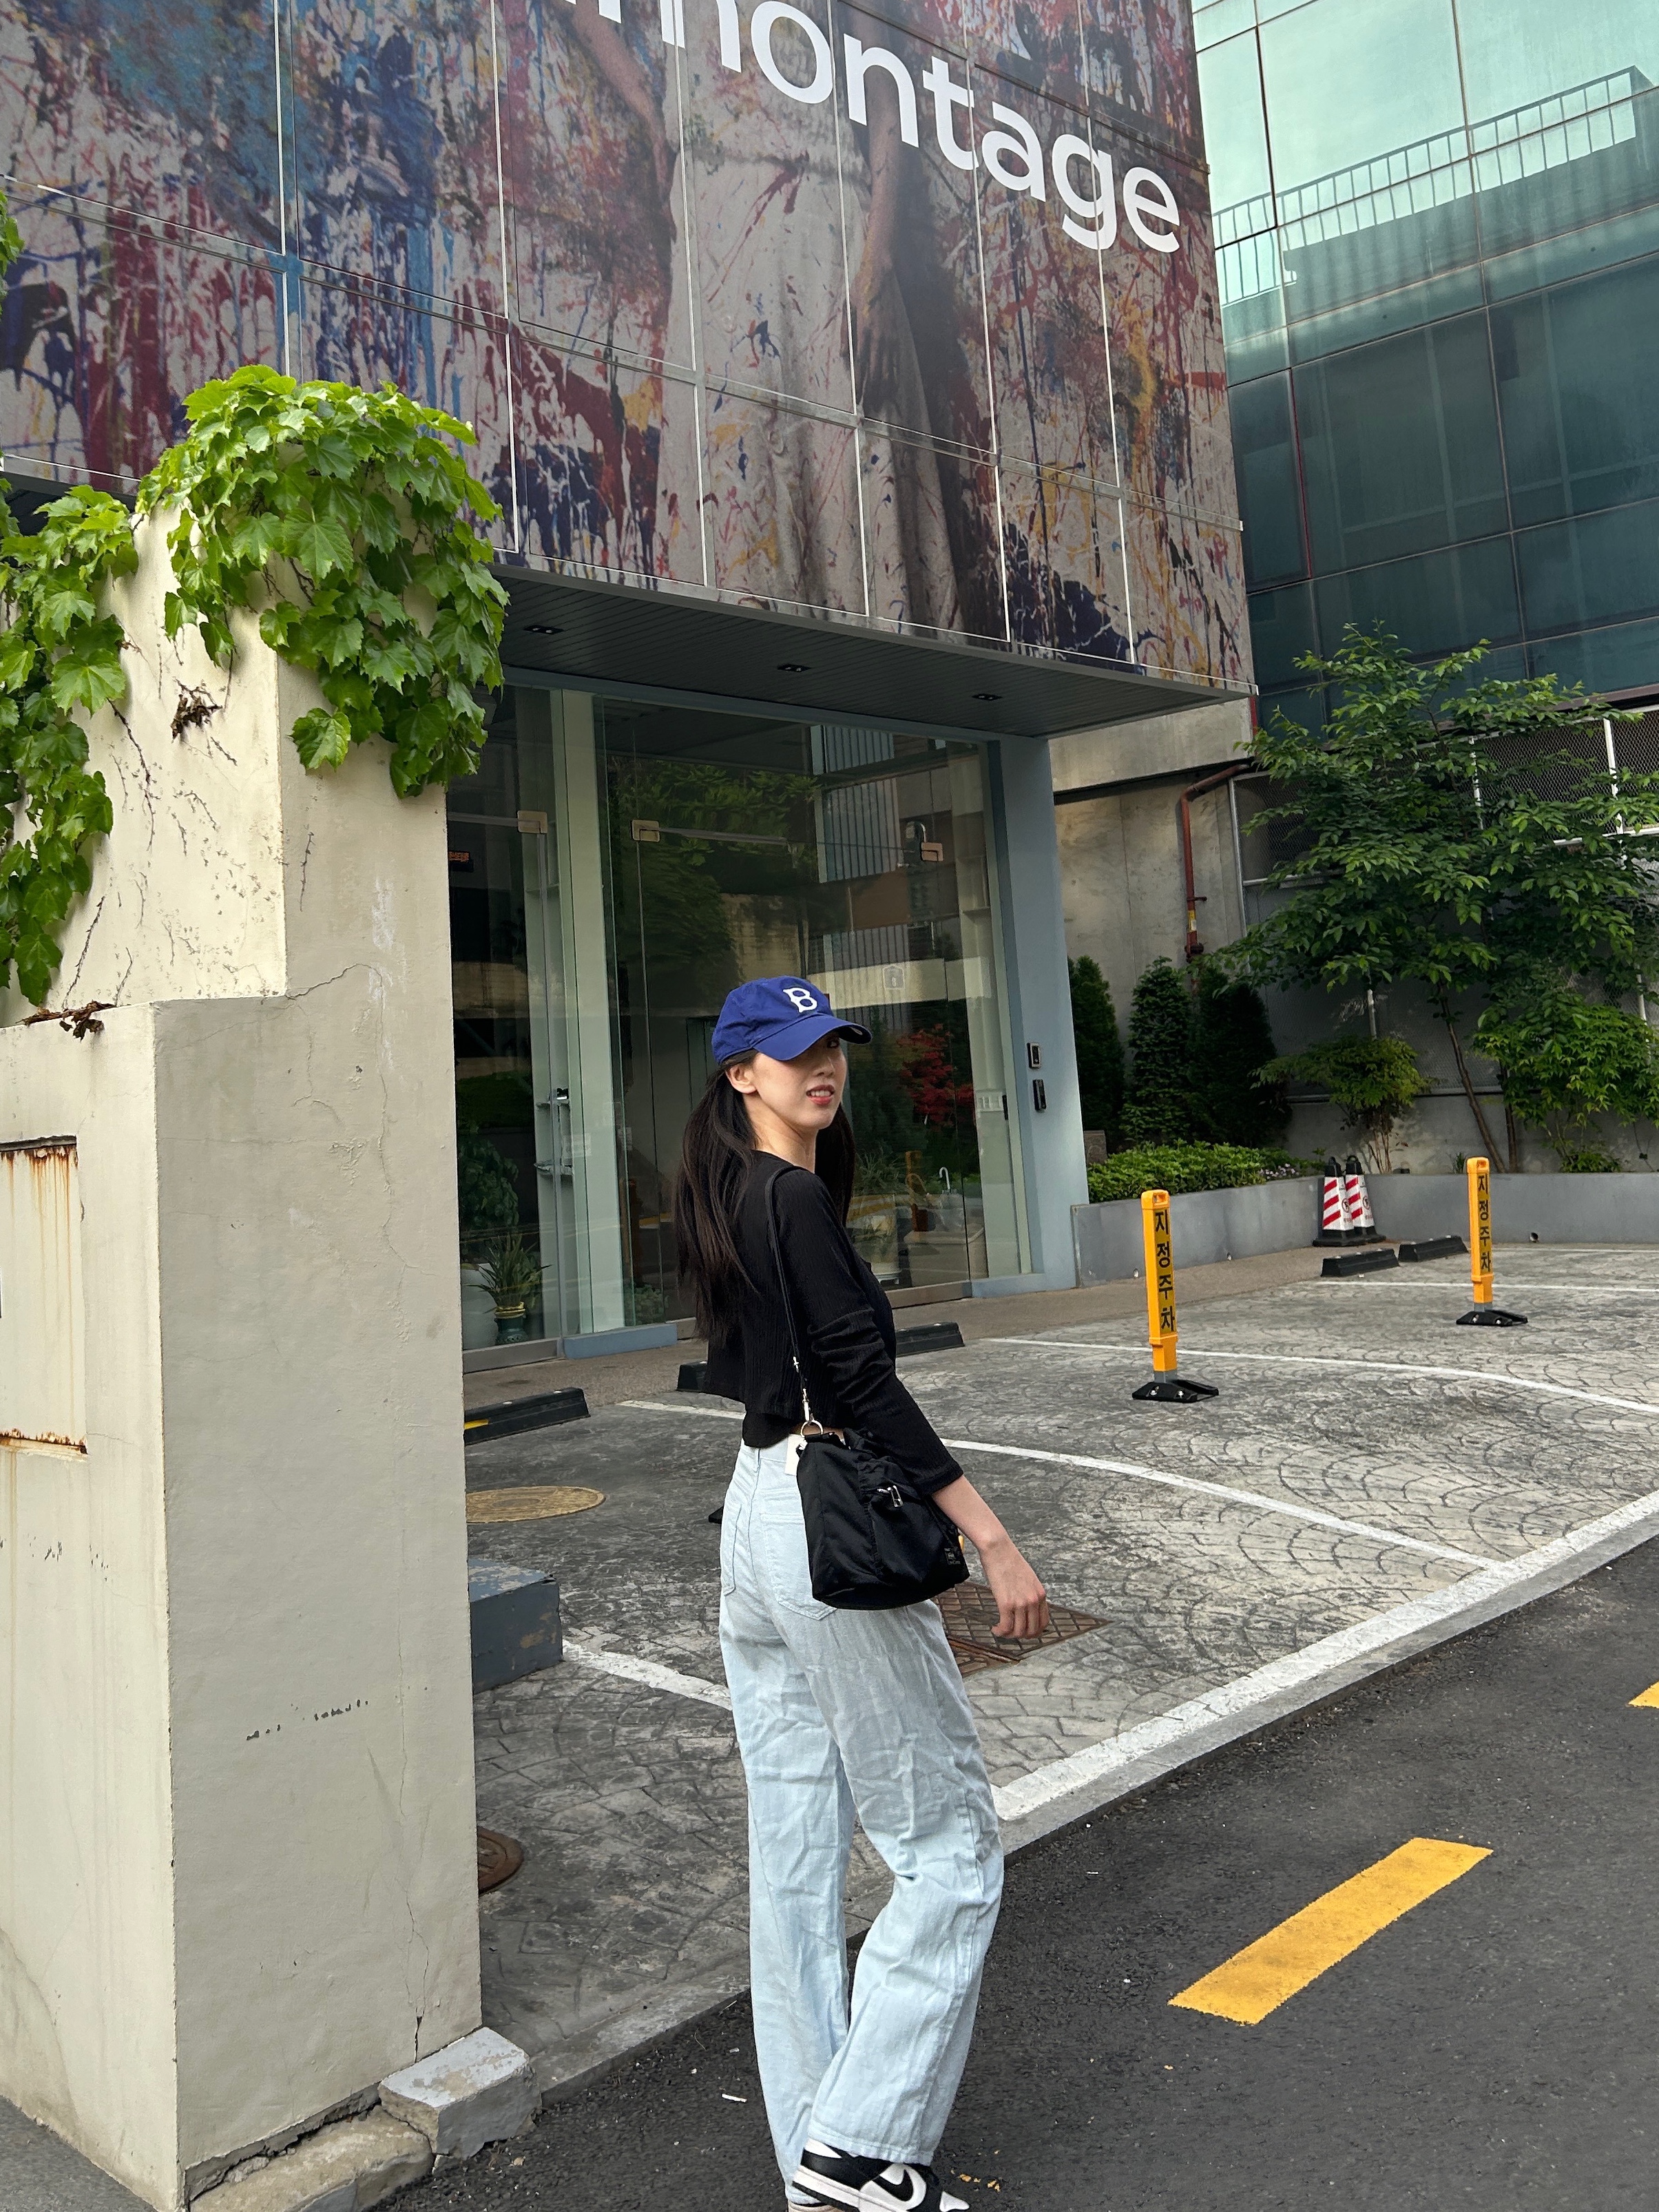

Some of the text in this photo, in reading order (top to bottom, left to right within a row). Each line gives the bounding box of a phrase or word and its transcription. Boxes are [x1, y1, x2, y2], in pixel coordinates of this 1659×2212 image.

[782, 986, 817, 1013] B
[1154, 1209, 1175, 1332] 지정주차
[1477, 1173, 1492, 1273] 지정주차
